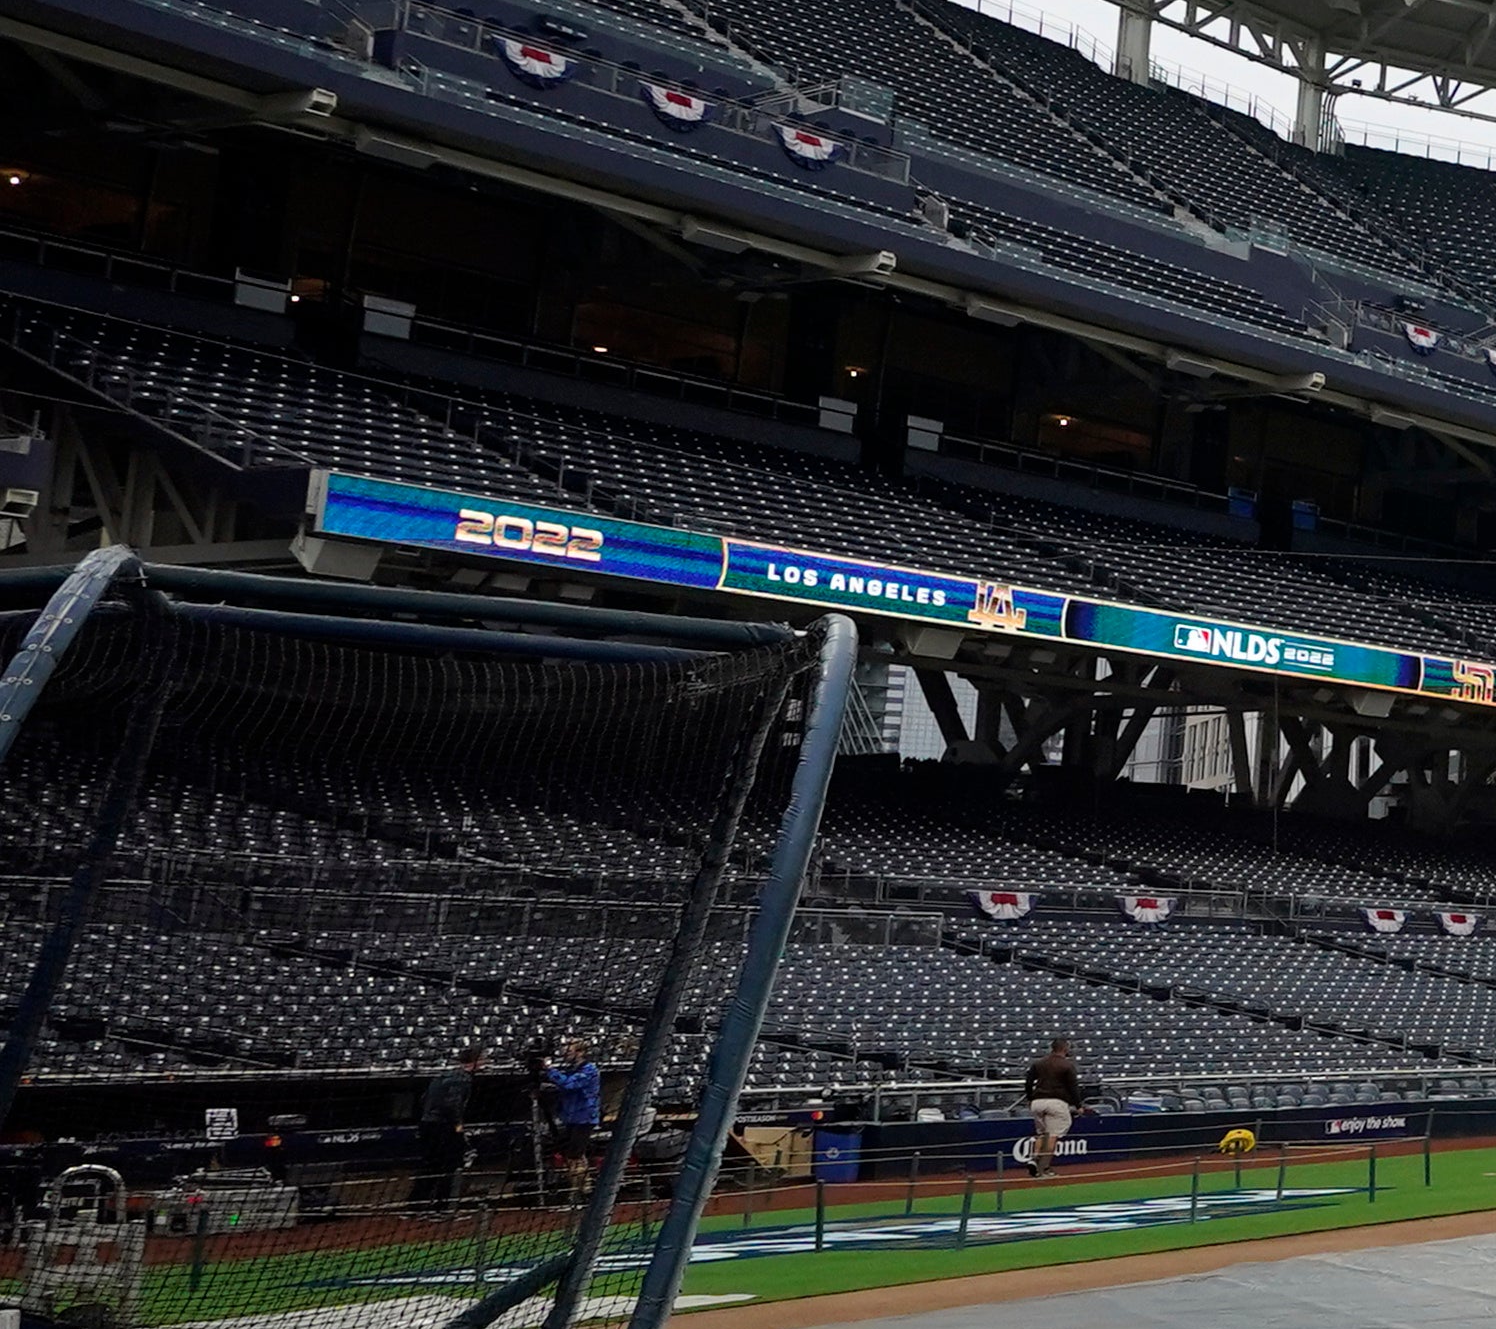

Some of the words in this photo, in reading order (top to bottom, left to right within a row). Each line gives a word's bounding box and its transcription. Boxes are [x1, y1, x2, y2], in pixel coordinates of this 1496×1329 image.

[457, 508, 605, 563] 2022
[767, 561, 818, 591] LOS
[829, 571, 948, 608] ANGELES
[1211, 627, 1281, 668] NLDS
[1284, 647, 1334, 667] 2022
[1340, 1116, 1366, 1134] enjoy
[1366, 1116, 1381, 1129] the
[1012, 1136, 1088, 1163] Cona
